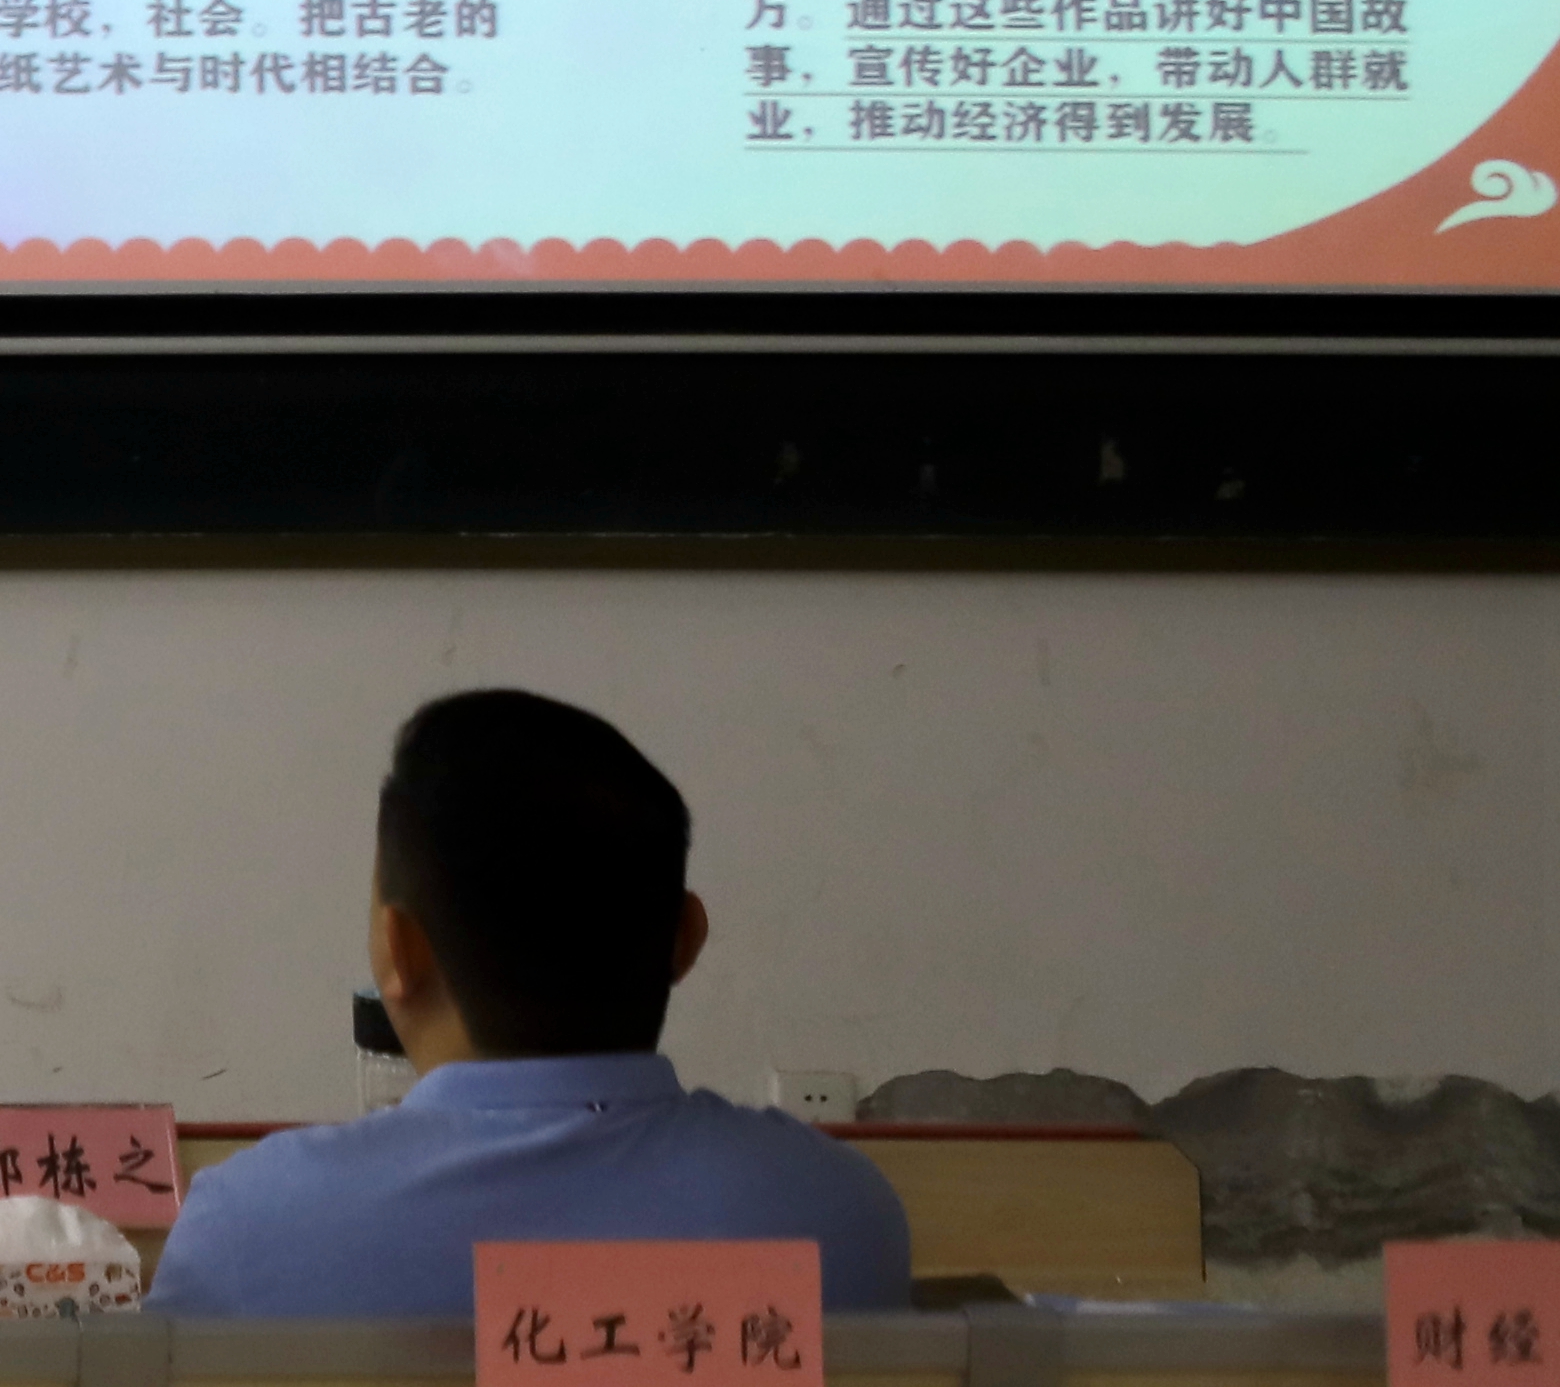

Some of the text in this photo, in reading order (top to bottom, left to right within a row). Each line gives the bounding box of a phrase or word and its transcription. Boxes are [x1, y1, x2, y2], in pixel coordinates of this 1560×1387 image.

[26, 1262, 86, 1283] C&S
[502, 1302, 802, 1373] 化工学院
[1413, 1304, 1542, 1370] 财经
